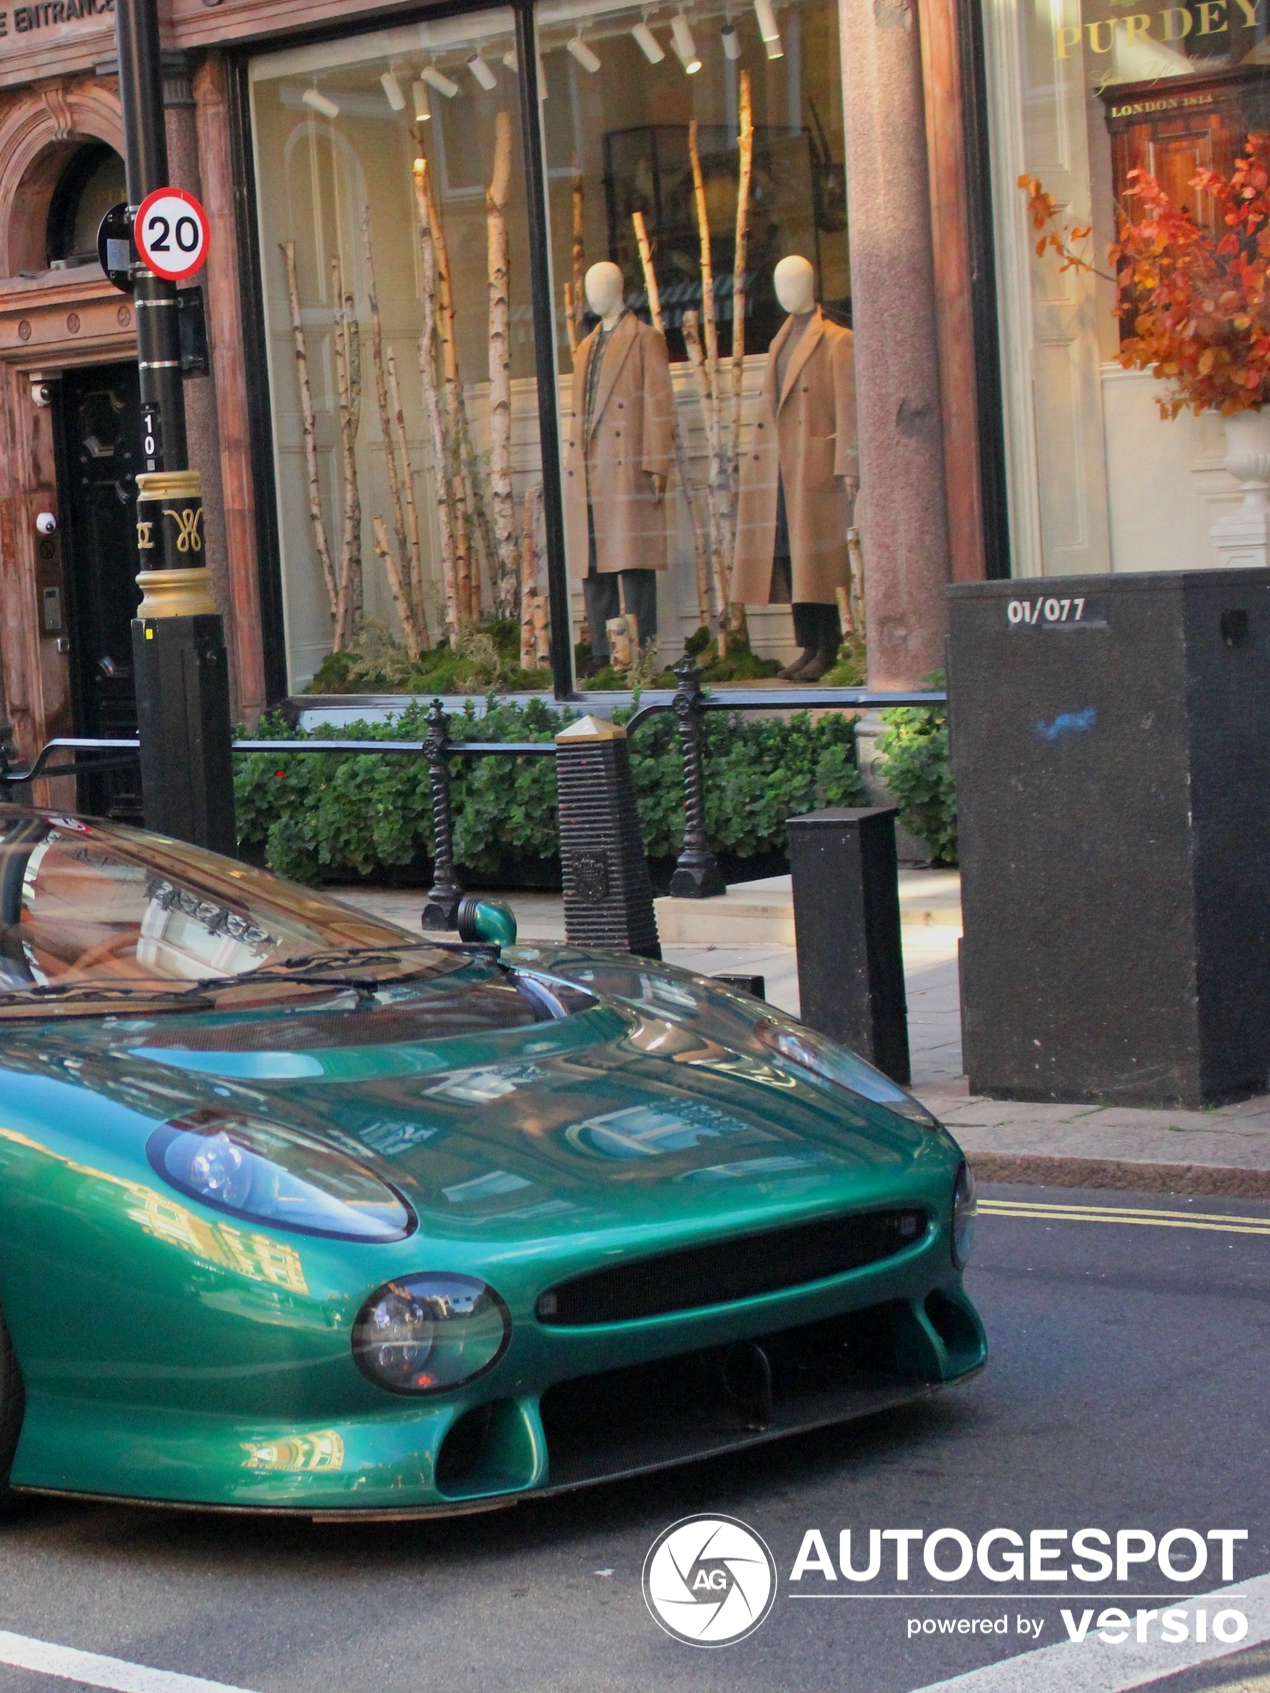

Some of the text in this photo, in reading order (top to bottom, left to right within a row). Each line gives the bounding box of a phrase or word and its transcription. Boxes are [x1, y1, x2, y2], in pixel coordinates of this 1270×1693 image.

[1053, 0, 1261, 60] PURDEY
[1111, 96, 1180, 118] LONDON
[148, 216, 199, 252] 20
[144, 414, 155, 455] 10
[1007, 596, 1085, 625] 01/077
